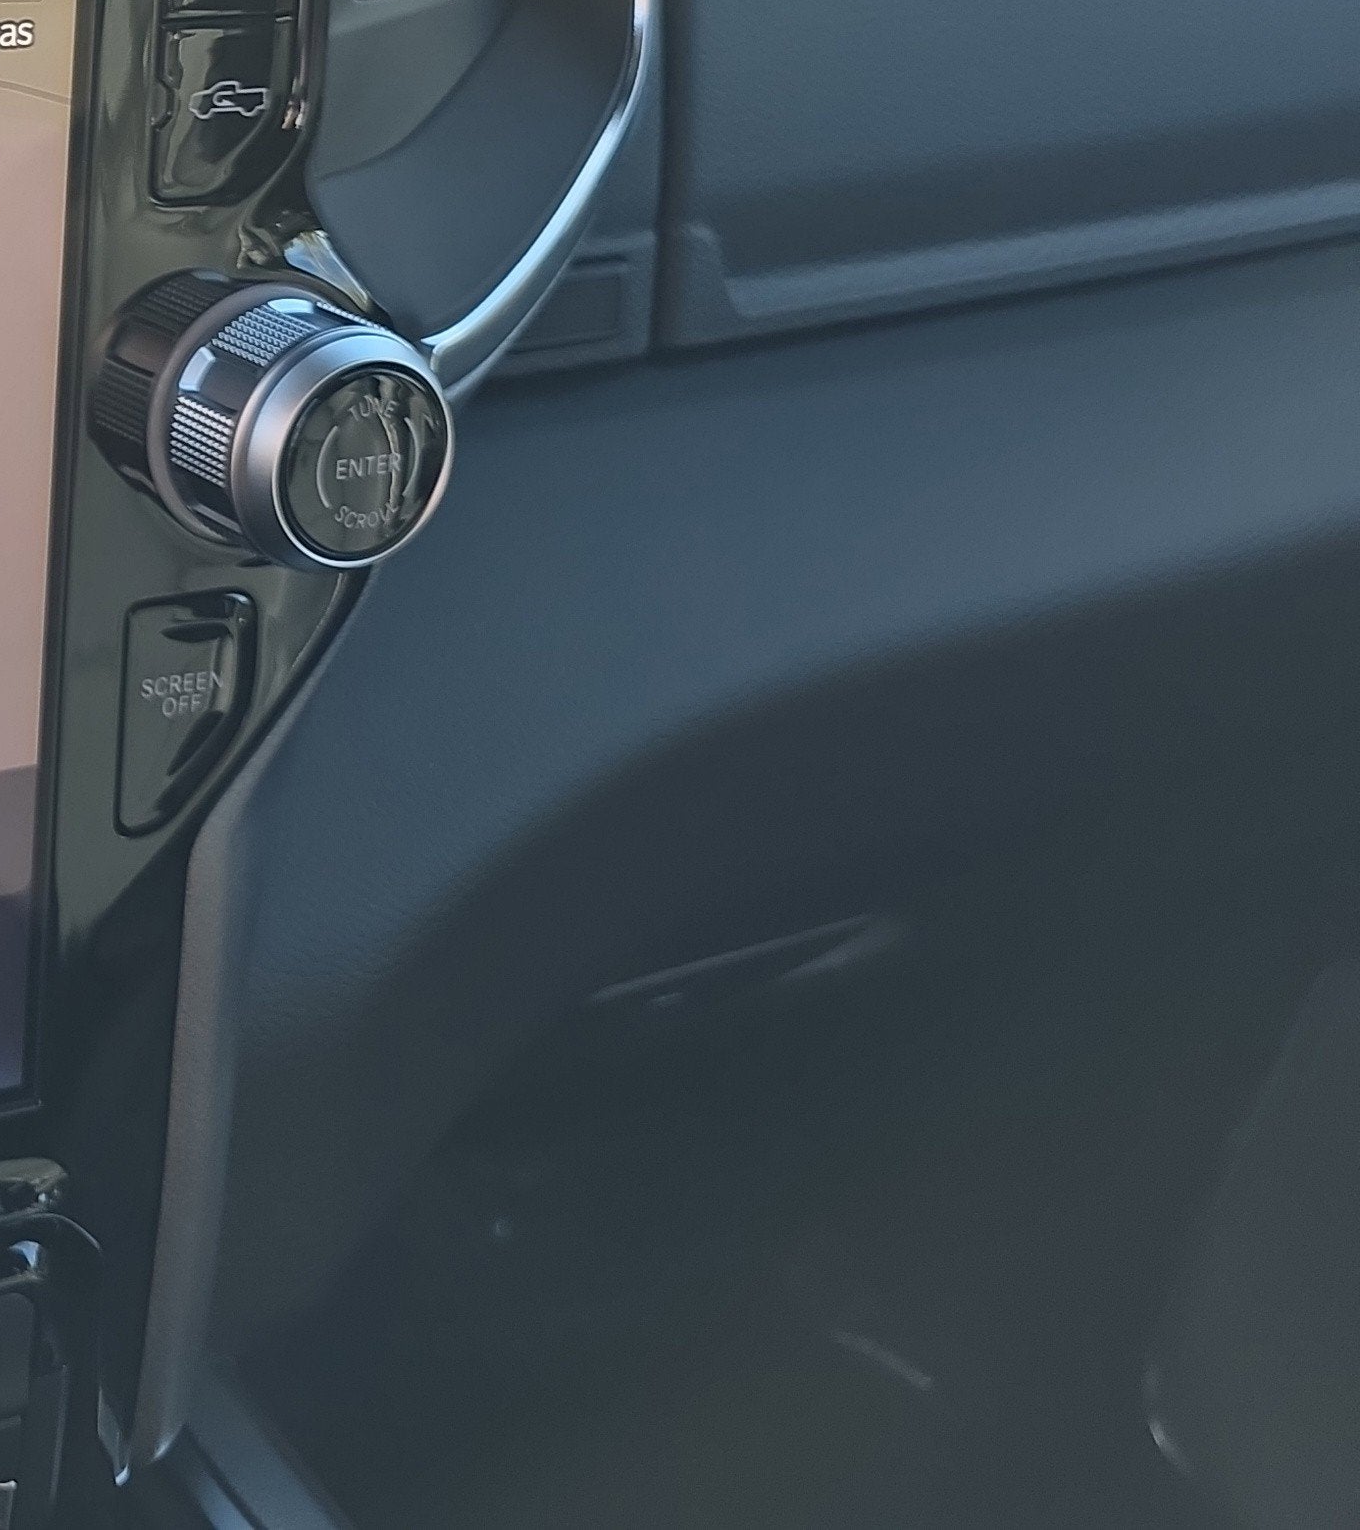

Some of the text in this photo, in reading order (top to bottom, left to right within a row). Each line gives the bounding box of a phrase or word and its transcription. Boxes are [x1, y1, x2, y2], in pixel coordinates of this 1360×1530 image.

[347, 395, 399, 422] TUNE
[335, 452, 402, 481] ENTER
[140, 670, 224, 700] SCREEN
[161, 693, 203, 718] OFF
